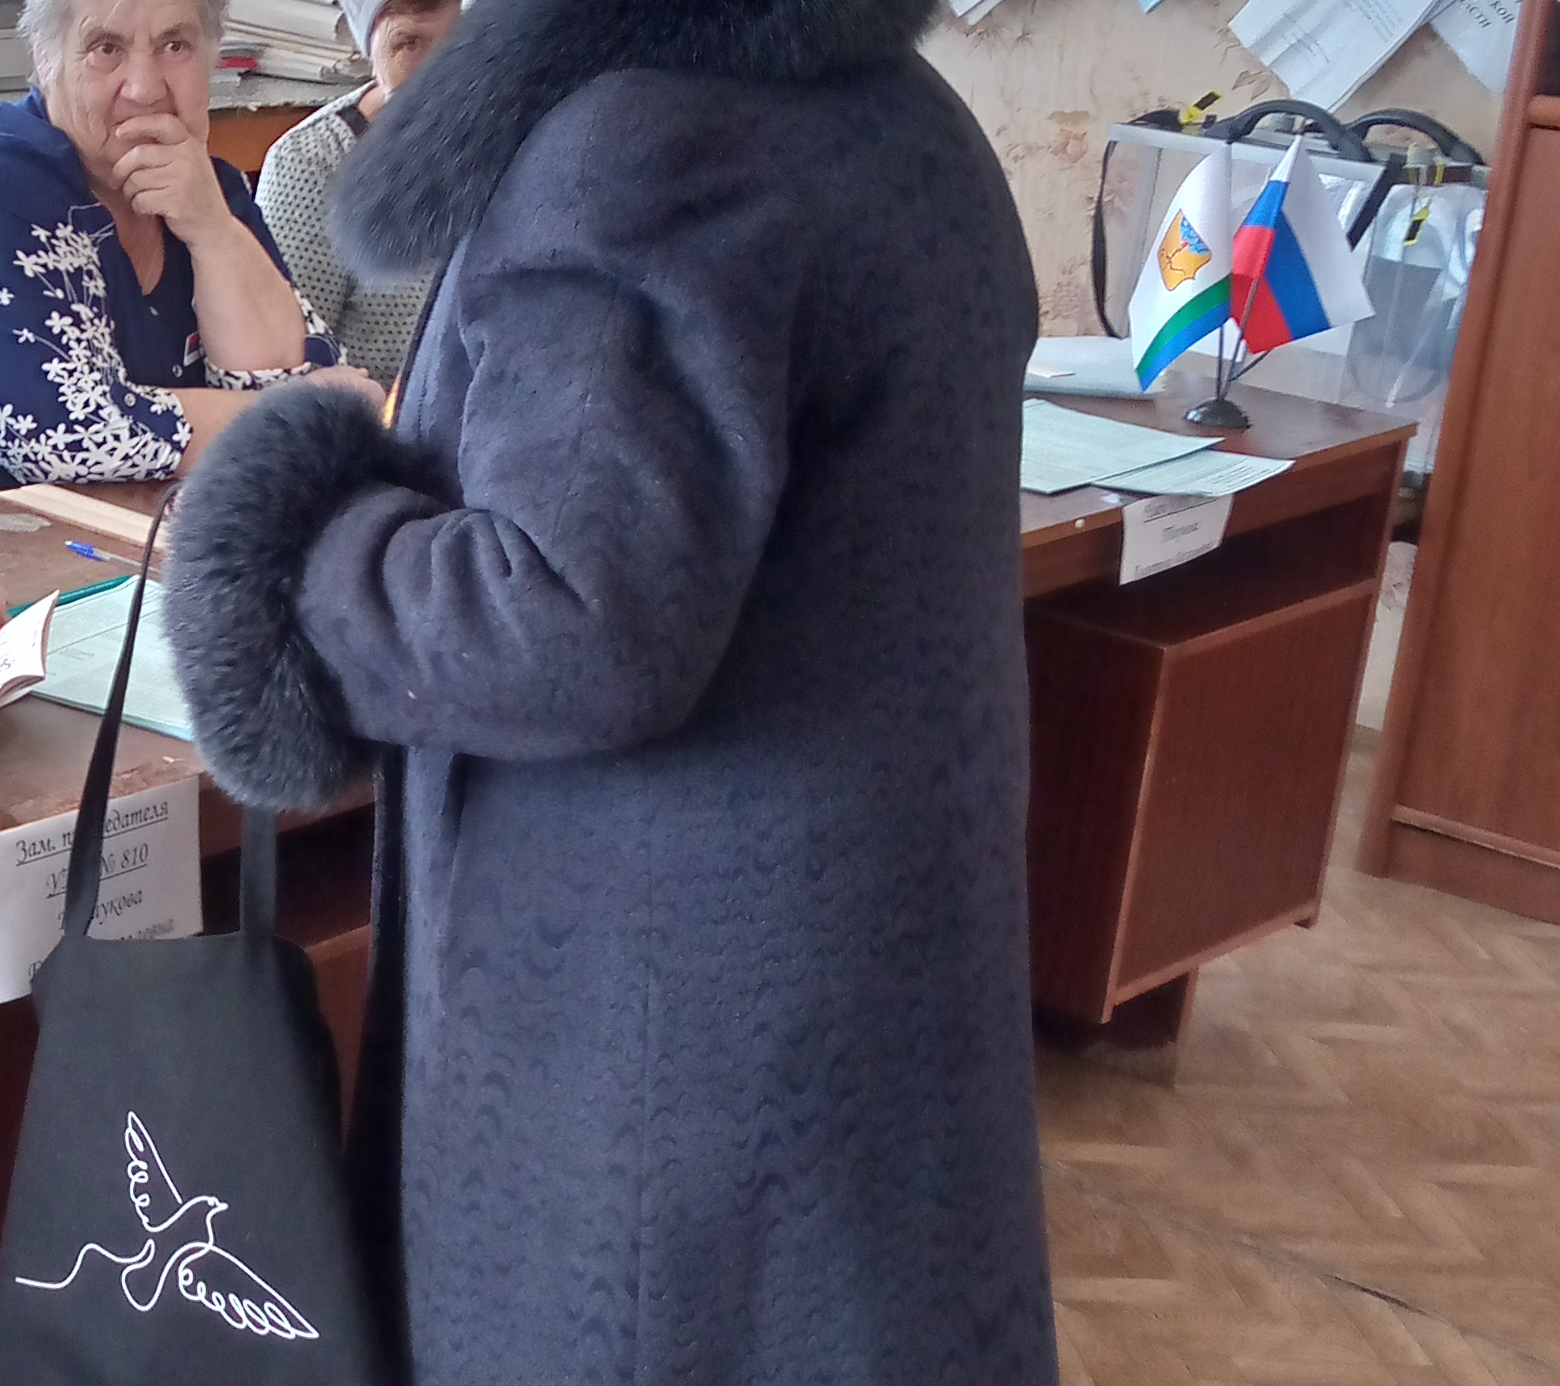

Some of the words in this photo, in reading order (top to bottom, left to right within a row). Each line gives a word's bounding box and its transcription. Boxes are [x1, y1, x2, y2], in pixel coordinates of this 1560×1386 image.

[16, 836, 56, 863] Зам.
[62, 801, 168, 847] педателя
[121, 843, 149, 869] 810
